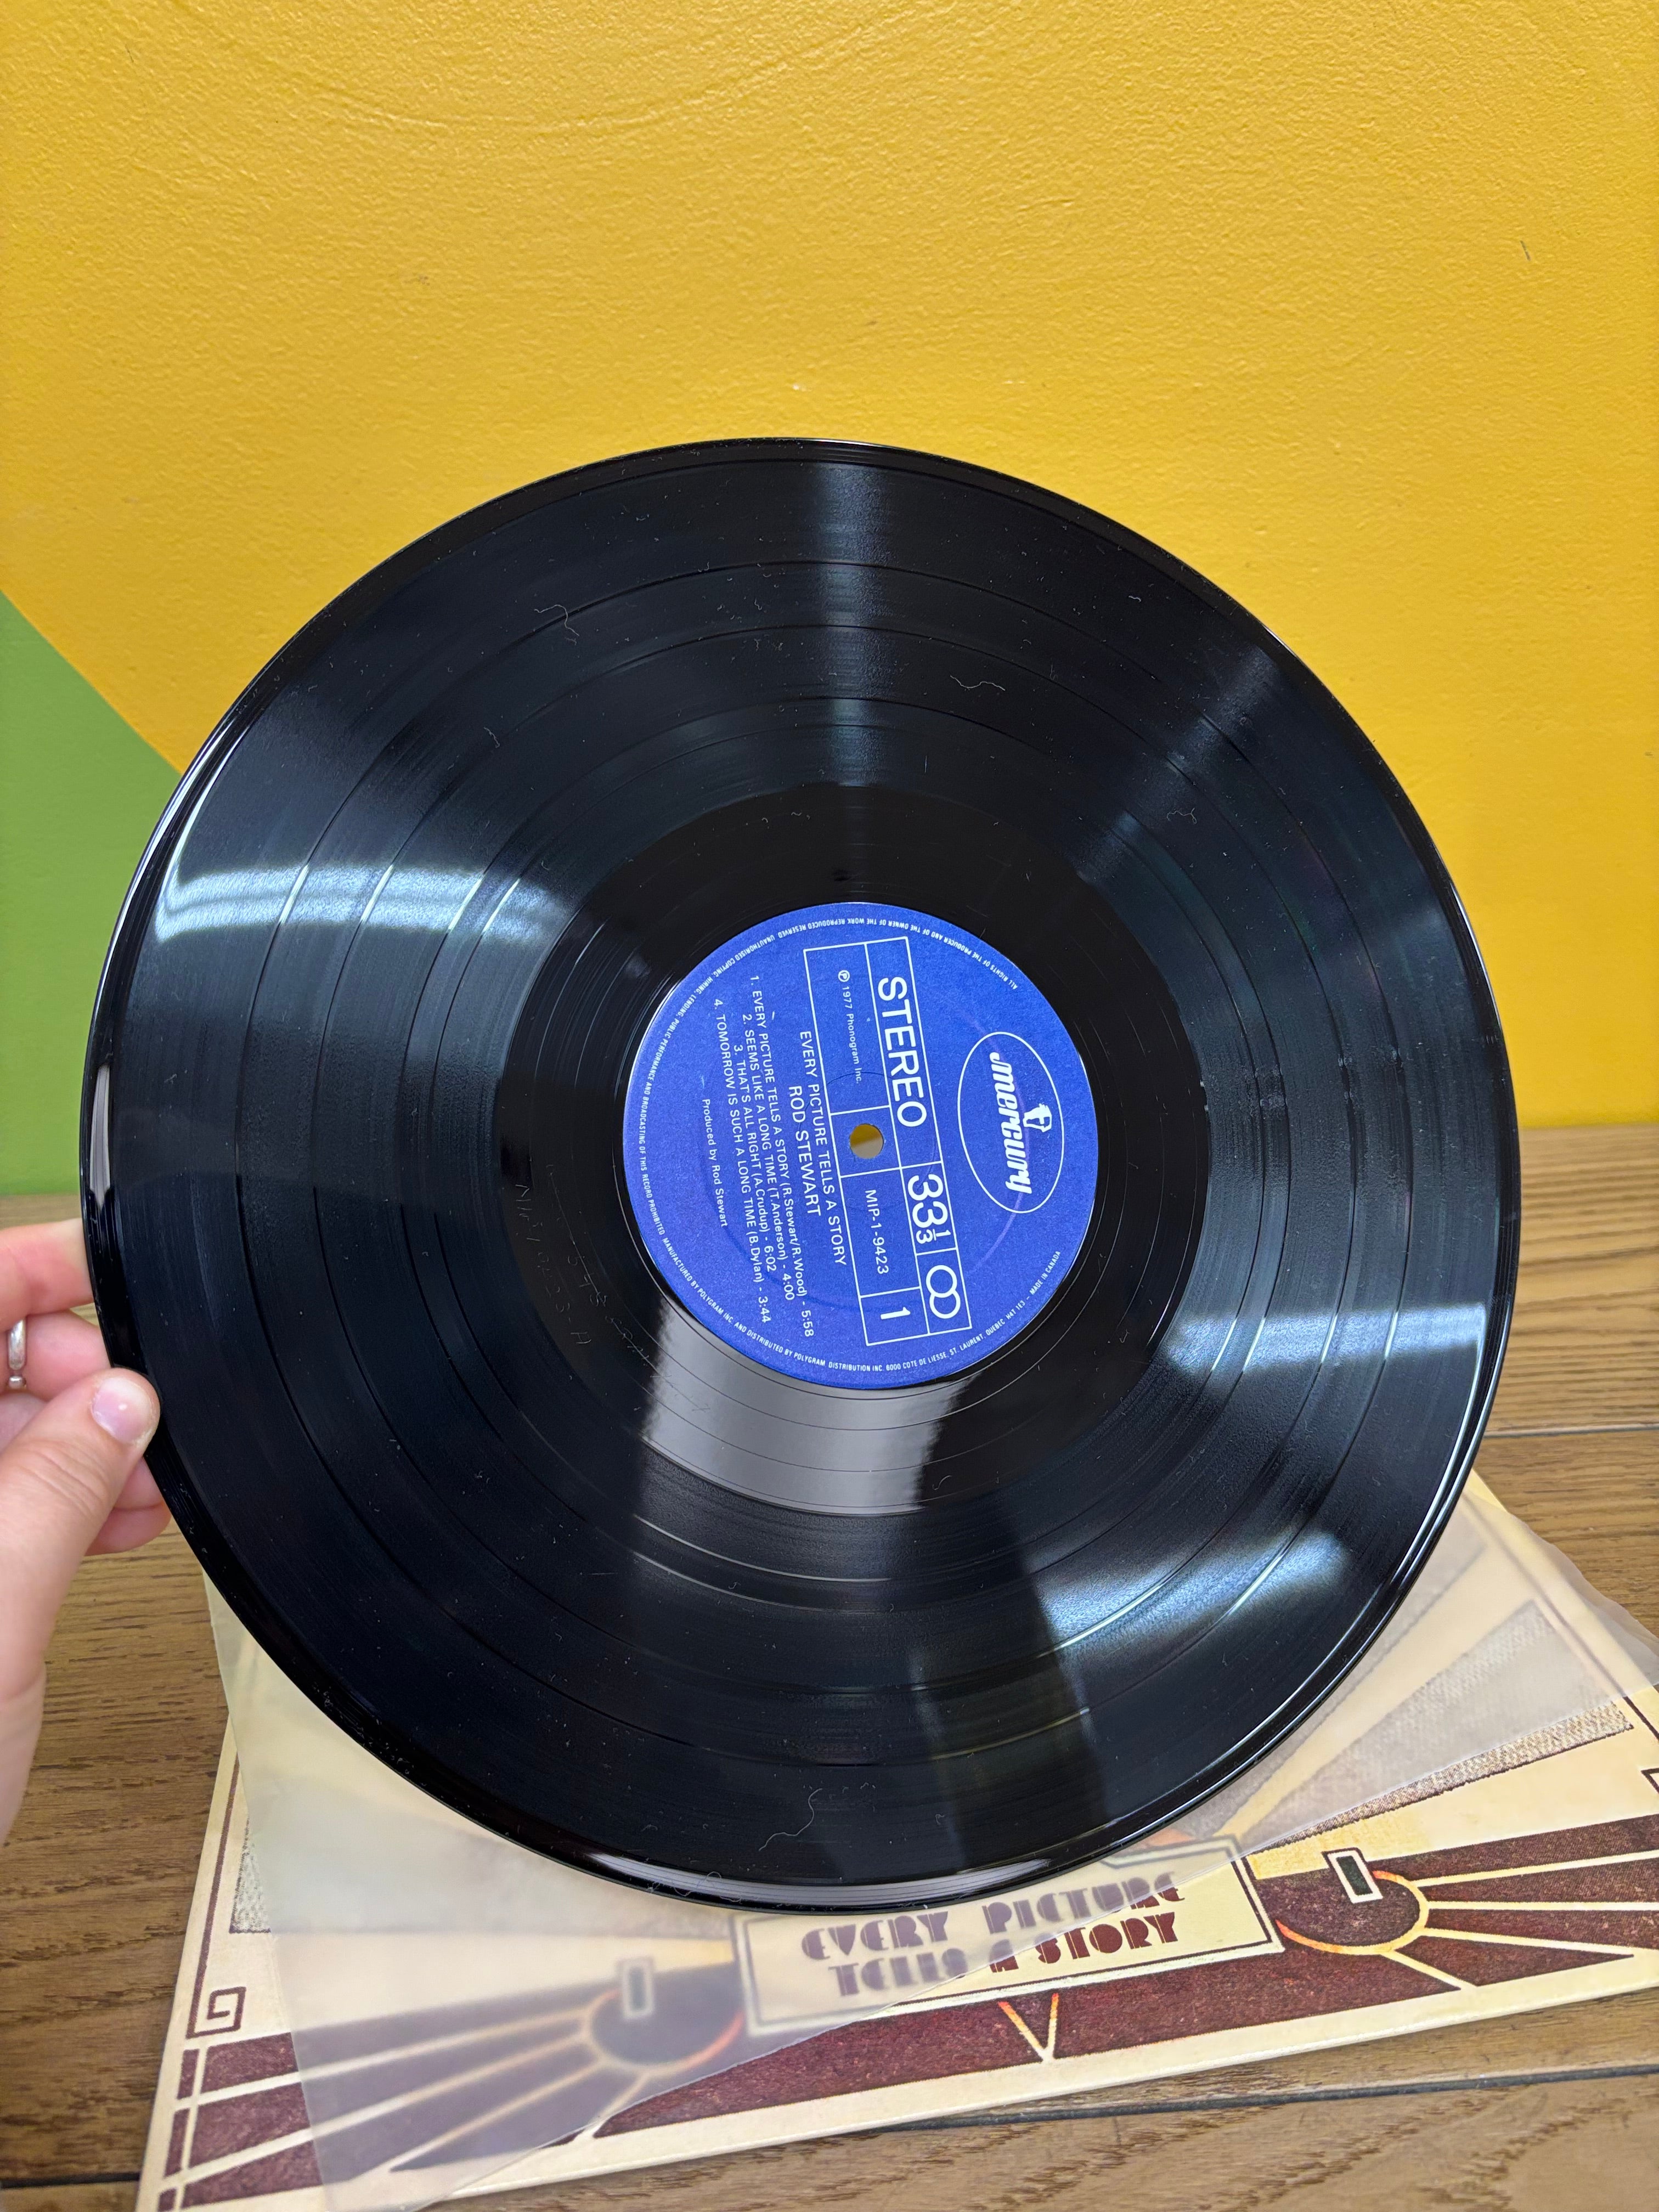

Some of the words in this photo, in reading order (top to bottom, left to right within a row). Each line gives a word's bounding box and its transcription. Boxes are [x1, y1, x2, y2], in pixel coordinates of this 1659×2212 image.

[778, 924, 806, 938] RESERVED
[809, 919, 845, 930] REPRODUCED
[888, 921, 909, 930] OWNER
[736, 935, 775, 961] UNAUTHORISED
[944, 937, 971, 955] PRODUCER
[970, 951, 983, 962] THE
[750, 975, 759, 985] 1.
[991, 965, 1009, 983] RIGHTS
[1009, 980, 1018, 989] ALL
[714, 998, 723, 1010] 4.
[753, 990, 766, 1028] EVERY
[842, 986, 853, 1009] 1977
[665, 1018, 679, 1039] PUBLIC
[742, 1014, 752, 1025] 2.
[716, 1014, 736, 1088] TOMORROW
[733, 1045, 743, 1055] 3.
[745, 1030, 760, 1071] SEEMS
[846, 1013, 860, 1065] Phonogram
[877, 977, 927, 1127] STEREO
[648, 1039, 668, 1081] PERFORMANCE
[759, 1032, 775, 1083] PICTURE
[800, 1031, 818, 1077] EVERY
[644, 1081, 653, 1094] AND
[727, 1093, 738, 1105] IS
[752, 1075, 764, 1101] LIKE
[743, 1107, 754, 1128] ALL
[757, 1105, 765, 1113] A
[768, 1087, 781, 1122] TELLS
[788, 1086, 806, 1122] ROD
[809, 1084, 827, 1146] PICTURE
[639, 1097, 650, 1144] BROADCASTING
[702, 1099, 716, 1146] Produced
[730, 1110, 743, 1143] SUCH
[758, 1118, 772, 1150] LONG
[774, 1127, 782, 1135] A
[710, 1149, 718, 1161] by
[736, 1148, 745, 1156] A
[747, 1133, 762, 1169] RIGHT
[775, 1139, 790, 1178] STORY
[712, 1165, 722, 1184] Rod
[737, 1160, 752, 1194] LONG
[764, 1154, 777, 1184] TIME
[795, 1130, 821, 1216] STEWART
[818, 1150, 835, 1195] TELLS
[642, 1174, 652, 1198] RECORD
[649, 1200, 665, 1235] PROHIBITED
[715, 1188, 727, 1227] Stewart
[743, 1197, 757, 1228] TIME
[826, 1200, 837, 1211] A
[828, 1215, 847, 1265] STORY
[865, 1189, 889, 1274] MIP-1-9423
[764, 1245, 777, 1272] 6:02
[782, 1273, 795, 1301] 4:00
[662, 1238, 692, 1282] MANUFACTURED
[691, 1280, 699, 1289] BY
[697, 1289, 723, 1315] POLYGRAM
[734, 1323, 746, 1333] AND
[747, 1330, 783, 1353] DISTRIBUTED
[794, 1352, 826, 1366] POLYGRAM
[828, 1362, 871, 1371] DISTRIBUTION
[902, 1361, 918, 1369] COTE
[986, 1318, 1005, 1336] QUEBEC
[1029, 1282, 1043, 1295] MADE
[1041, 1273, 1047, 1282] IN
[1046, 1251, 1061, 1274] CANADA
[758, 1296, 771, 1323] 3:44
[881, 1307, 911, 1319] 1
[802, 1310, 814, 1336] 5:58
[800, 1912, 950, 1962] EVERY
[982, 1872, 1185, 1935] PICTURE
[827, 1946, 969, 1998] TELLS
[990, 1939, 1019, 1973] A
[1035, 1912, 1178, 1966] STORY
